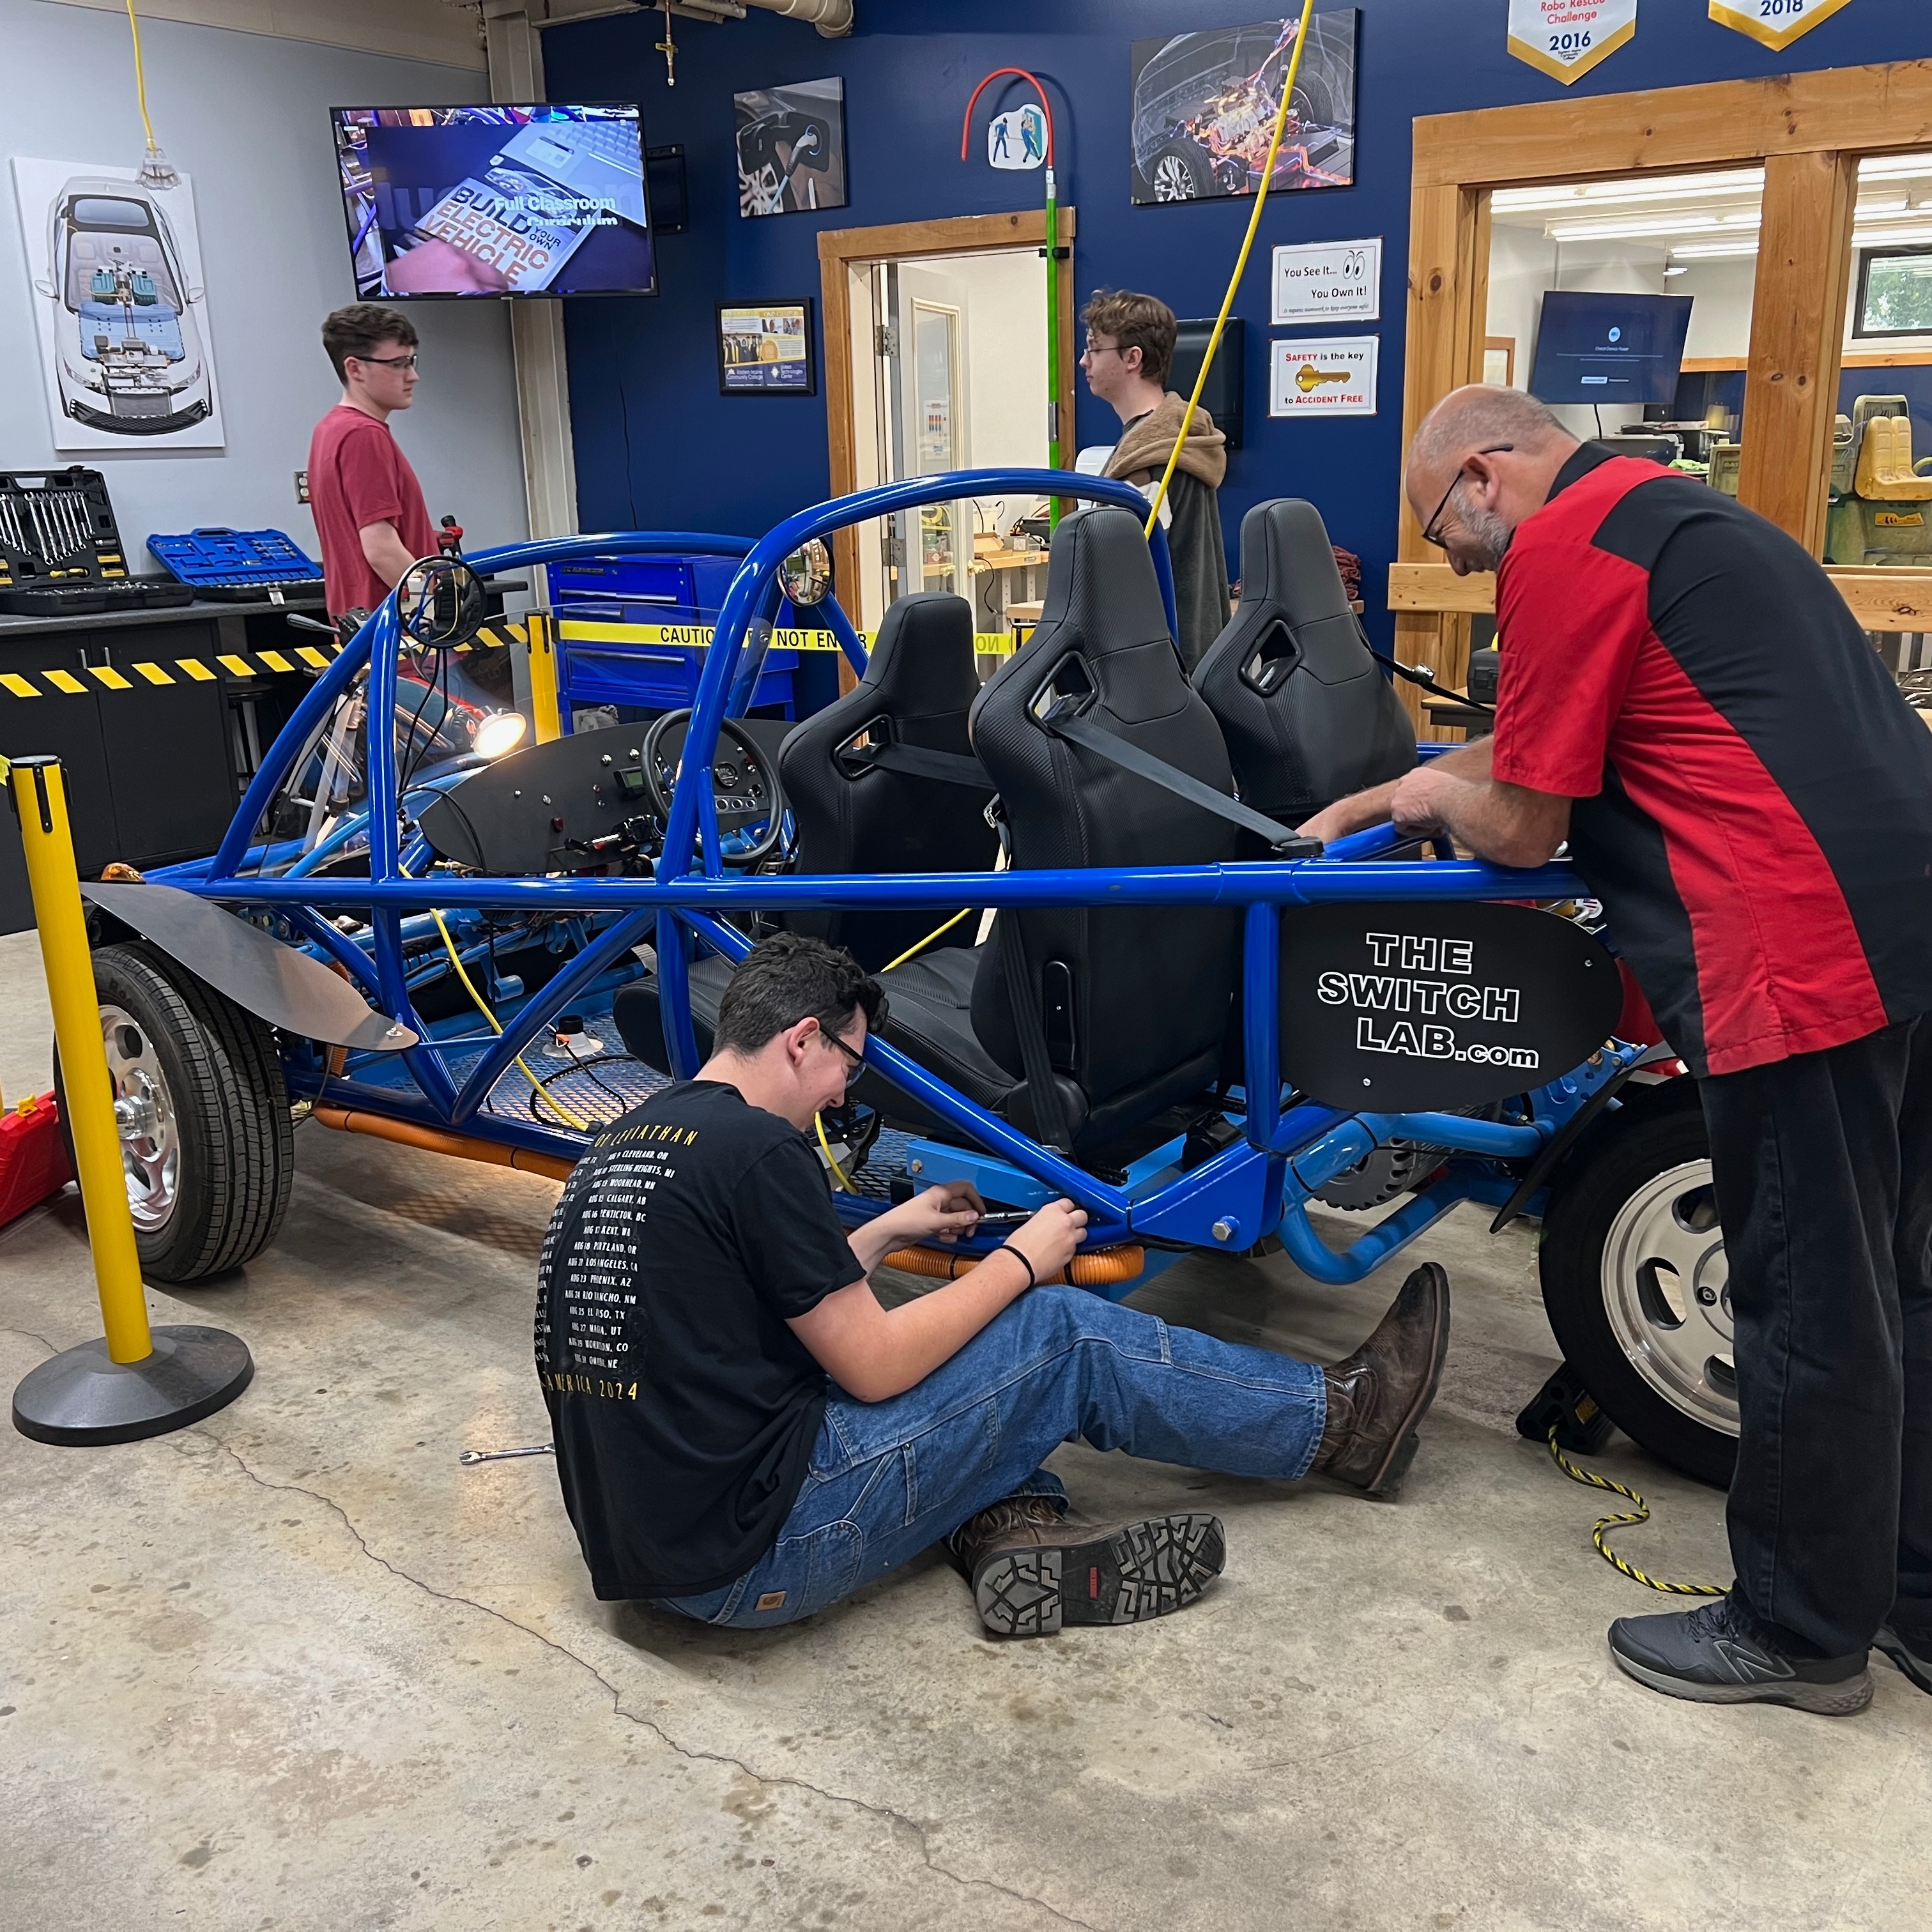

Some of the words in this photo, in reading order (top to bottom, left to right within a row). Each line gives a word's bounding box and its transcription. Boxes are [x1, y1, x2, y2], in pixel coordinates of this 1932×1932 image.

[1540, 0, 1565, 12] Robo
[1760, 0, 1803, 16] 2018
[1547, 12, 1597, 24] Challenge
[1549, 31, 1591, 50] 2016
[494, 196, 525, 211] Full
[527, 195, 616, 210] Classroom
[450, 186, 532, 234] BUILD
[436, 201, 549, 270] ELECTRIC
[529, 233, 553, 250] OWN
[534, 226, 562, 247] YOUR
[1284, 268, 1301, 277] You
[1304, 267, 1320, 276] See
[1311, 289, 1328, 298] You
[1331, 288, 1353, 297] Own
[1356, 286, 1367, 296] It!
[1348, 351, 1364, 360] key
[1296, 395, 1338, 404] ACCIDENT
[1341, 394, 1363, 402] FREE
[661, 627, 715, 644] CAUTIO
[777, 631, 808, 647] NOT
[817, 632, 867, 648] ENR
[1366, 932, 1473, 974] THE
[1317, 971, 1520, 1023] SWITCH
[1356, 1017, 1539, 1069] LAB.com
[594, 1133, 611, 1147] OF
[656, 1151, 669, 1160] OH
[664, 1169, 675, 1178] MI
[644, 1180, 656, 1190] MN
[636, 1195, 647, 1205] AB
[635, 1212, 647, 1222] BC
[621, 1227, 631, 1237] WA
[627, 1245, 638, 1255] OR
[585, 1257, 597, 1267] LOS
[631, 1262, 638, 1272] CA
[620, 1277, 632, 1287] AZ
[624, 1294, 636, 1305] NM
[615, 1310, 625, 1320] TX
[611, 1326, 622, 1335] UT
[616, 1343, 629, 1352] CO
[608, 1359, 618, 1368] NE
[599, 1379, 637, 1400] 2024
